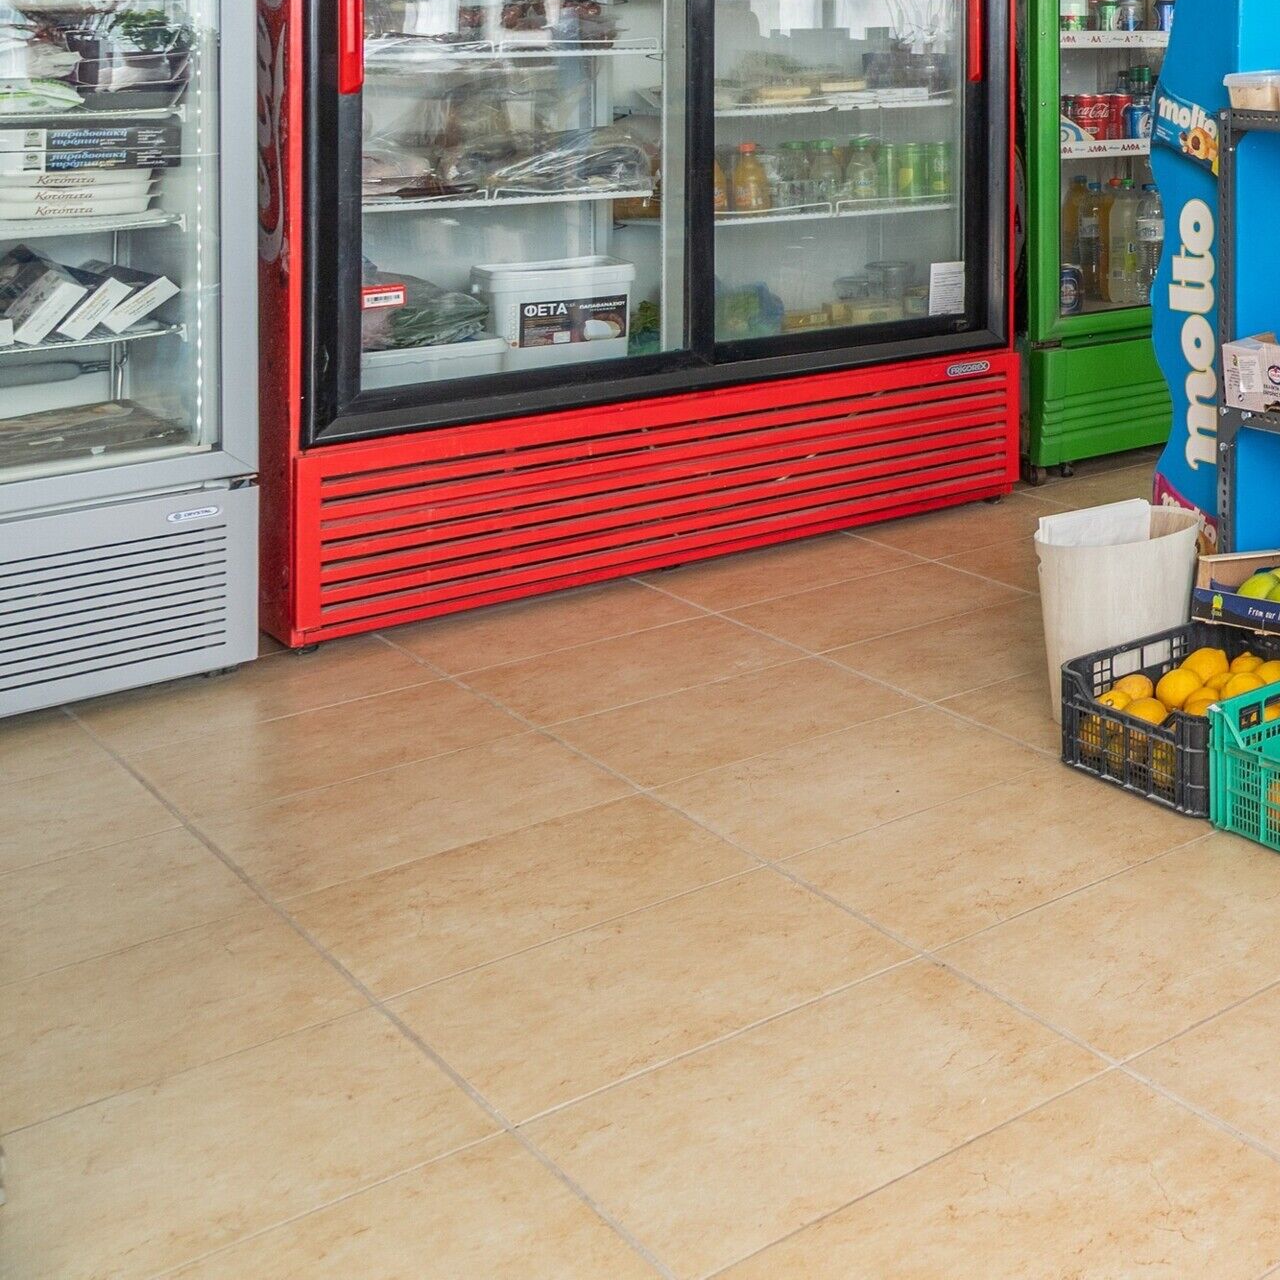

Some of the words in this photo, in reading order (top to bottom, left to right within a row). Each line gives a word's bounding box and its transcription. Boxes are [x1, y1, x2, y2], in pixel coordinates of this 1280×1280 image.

[1157, 96, 1218, 139] molto
[1120, 143, 1140, 152] ΑΛΦΑ
[35, 175, 96, 185] Κοτόπιτα
[34, 191, 94, 201] Κοτόπιτα
[35, 205, 94, 216] Κοτόπιτα
[523, 303, 569, 318] ΦΕΤΑ
[1168, 198, 1217, 471] molto
[950, 362, 988, 376] FRIGOREX
[1248, 606, 1264, 620] From
[1265, 610, 1277, 621] our
